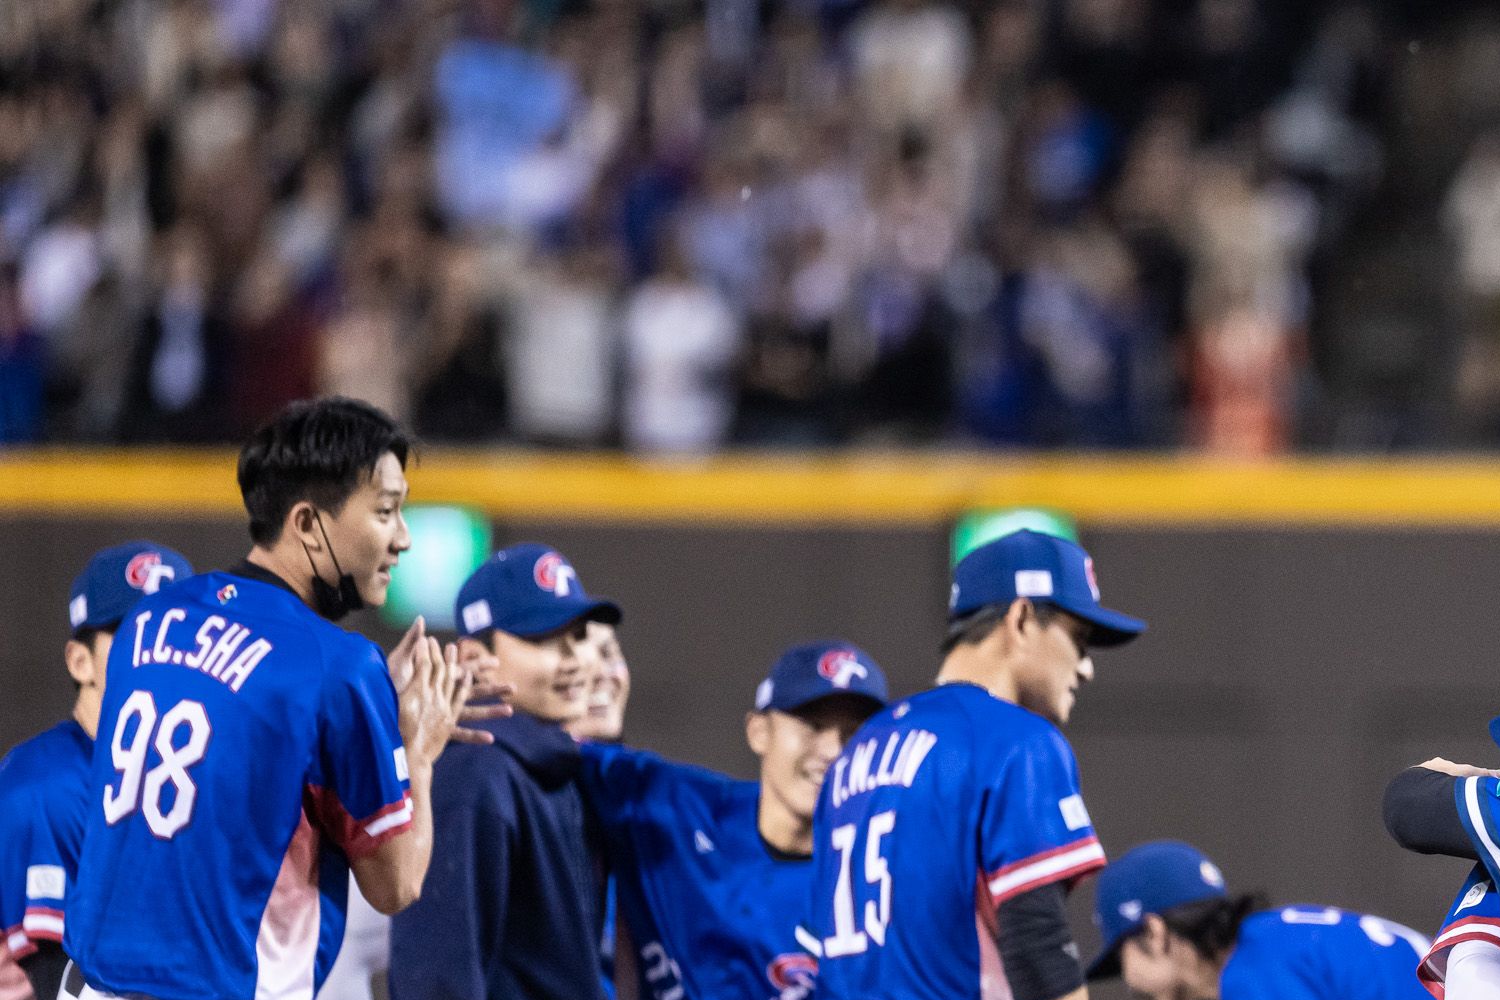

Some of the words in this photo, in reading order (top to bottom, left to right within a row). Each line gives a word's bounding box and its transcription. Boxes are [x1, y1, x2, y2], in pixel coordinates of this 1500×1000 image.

[132, 608, 273, 694] T.C.SHA
[103, 689, 213, 840] 98
[824, 809, 896, 959] 15
